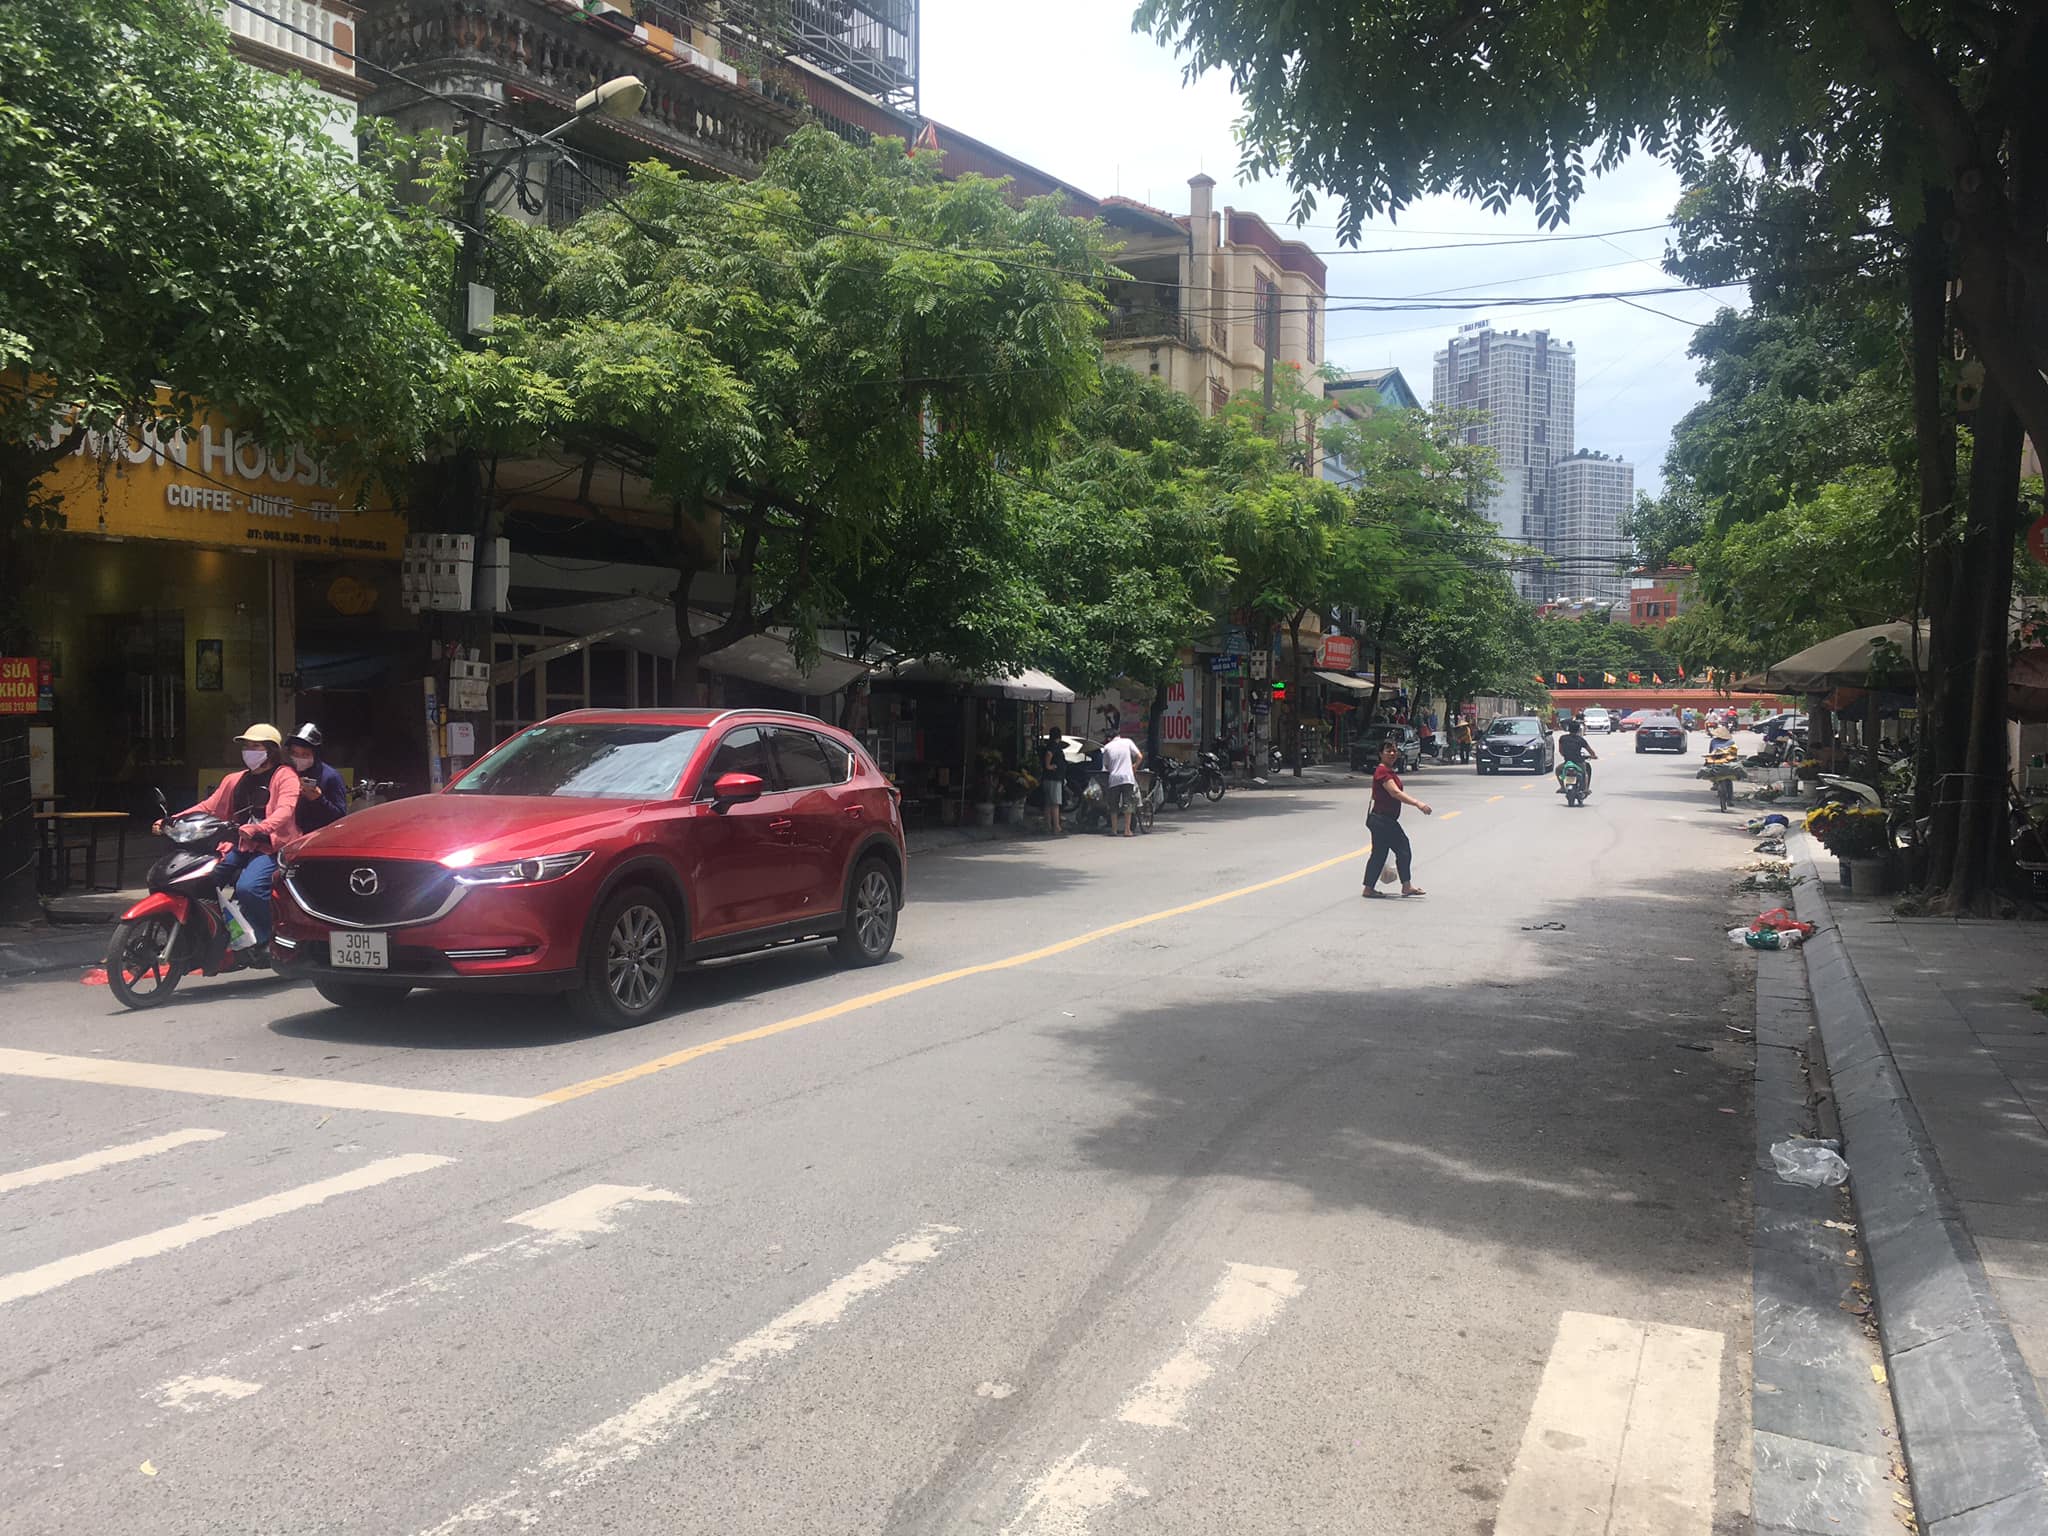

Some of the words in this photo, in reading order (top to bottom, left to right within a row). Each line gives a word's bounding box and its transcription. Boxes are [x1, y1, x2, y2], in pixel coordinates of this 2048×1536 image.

[167, 483, 232, 512] COFFEE
[248, 493, 294, 519] JUICE
[311, 501, 340, 523] TEA
[2, 659, 31, 678] SỬA
[0, 679, 36, 697] KHÓA
[345, 934, 370, 949] 30H
[336, 950, 381, 966] 348.75
